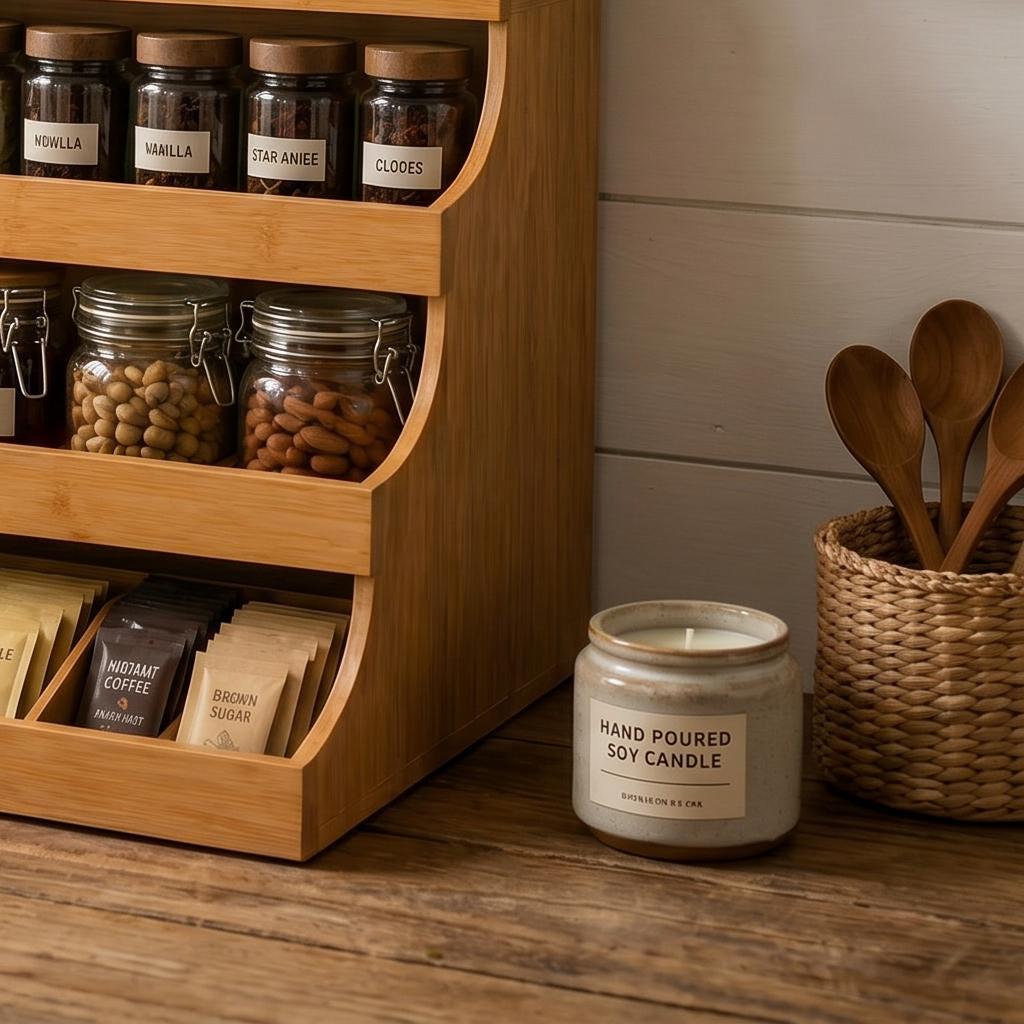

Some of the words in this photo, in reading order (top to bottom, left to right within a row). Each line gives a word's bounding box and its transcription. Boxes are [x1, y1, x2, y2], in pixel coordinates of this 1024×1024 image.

[252, 148, 277, 165] STAR
[104, 676, 152, 695] COFFEE
[209, 705, 252, 724] SUGAR
[600, 718, 645, 742] HAND
[652, 729, 731, 747] POURED
[607, 743, 639, 763] SOY
[645, 750, 722, 769] CANDLE
